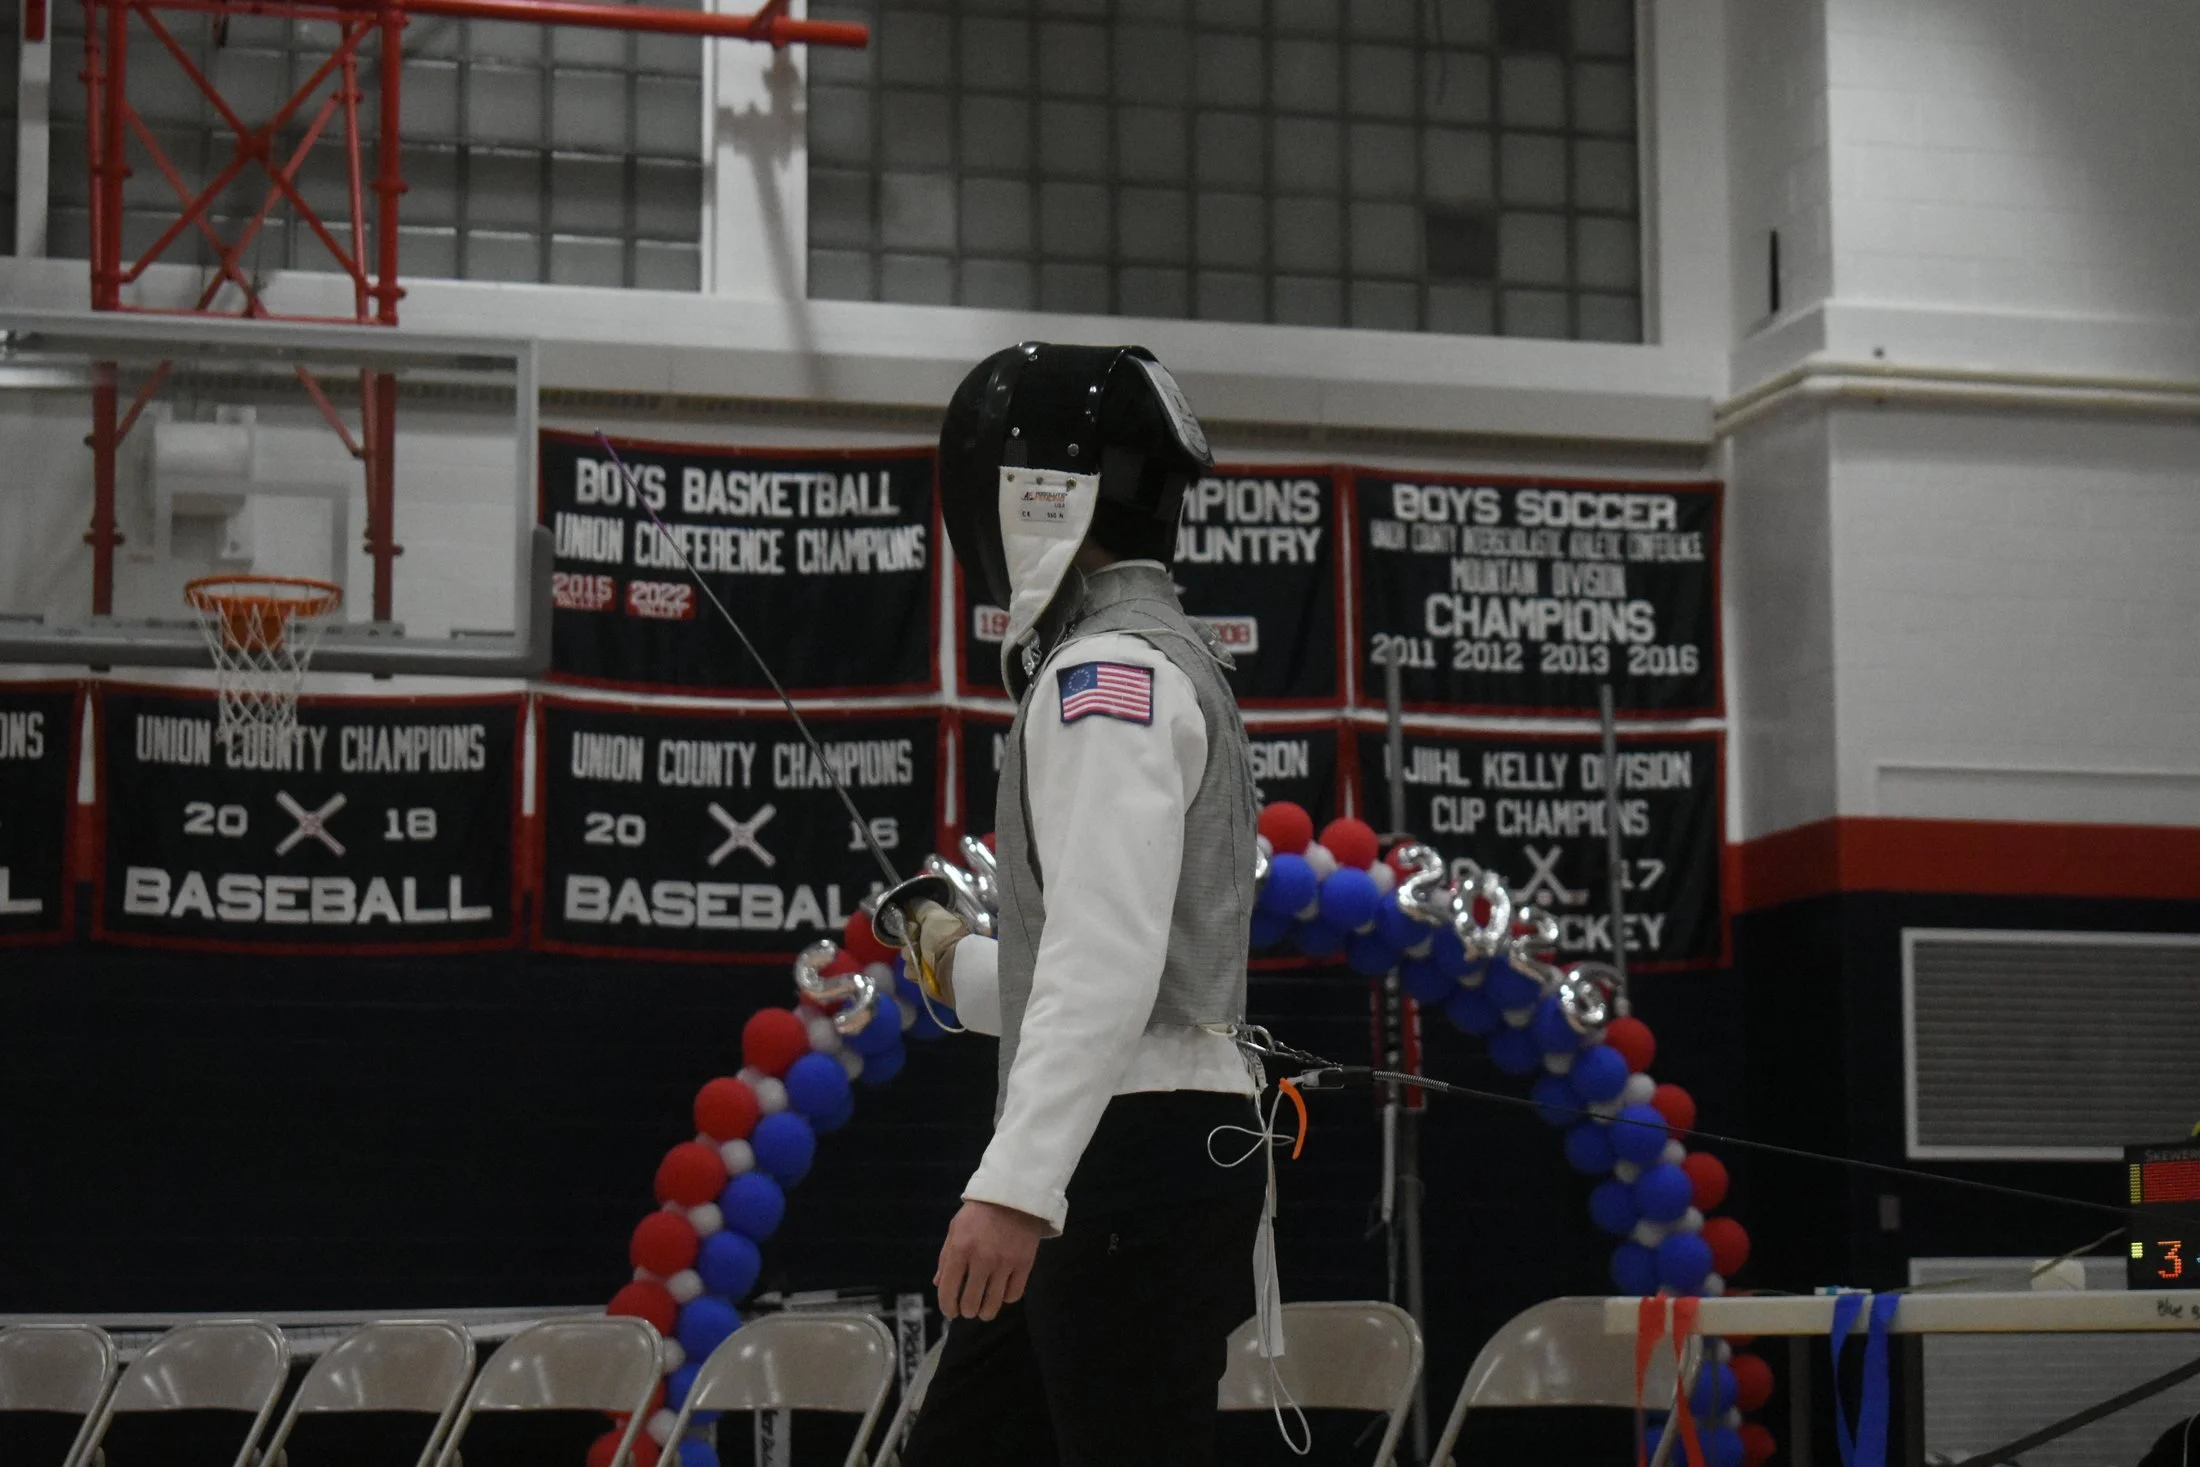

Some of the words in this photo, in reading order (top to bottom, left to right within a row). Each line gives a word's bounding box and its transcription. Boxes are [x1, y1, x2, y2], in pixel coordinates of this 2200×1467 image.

[576, 457, 667, 512] BOYS
[682, 467, 901, 518] BASKETBALL
[1392, 483, 1502, 525] BOYS
[1515, 489, 1678, 531] SOCCER
[554, 511, 625, 565] UNION
[635, 520, 786, 575] CONFERENCE
[796, 523, 926, 574] CHAMPIONS
[630, 580, 692, 603] 2022
[1451, 557, 1539, 595] MOUNTAIN
[1552, 560, 1627, 598] DIVISION
[1425, 594, 1656, 644] CHAMPIONS
[1370, 632, 1437, 669] 2011
[1452, 640, 1524, 673] 2012
[1540, 643, 1610, 675] 2013
[1628, 644, 1699, 676] 2016
[136, 713, 211, 765] UNION
[226, 722, 328, 773] COUNTY
[340, 724, 486, 773] CHAMPIONS
[571, 731, 644, 784] UNION
[658, 738, 757, 788] COUNTY
[773, 738, 914, 789] CHAMPIONS
[1483, 750, 1569, 791] KELLY
[183, 802, 249, 837] 20
[384, 808, 438, 842] 18
[583, 811, 647, 847] 20
[1431, 797, 1486, 835] CUP
[123, 865, 493, 925] BASEBALL
[564, 874, 884, 931] BASEBAL
[1558, 913, 1667, 952] CKEY
[2157, 1240, 2182, 1279] 3
